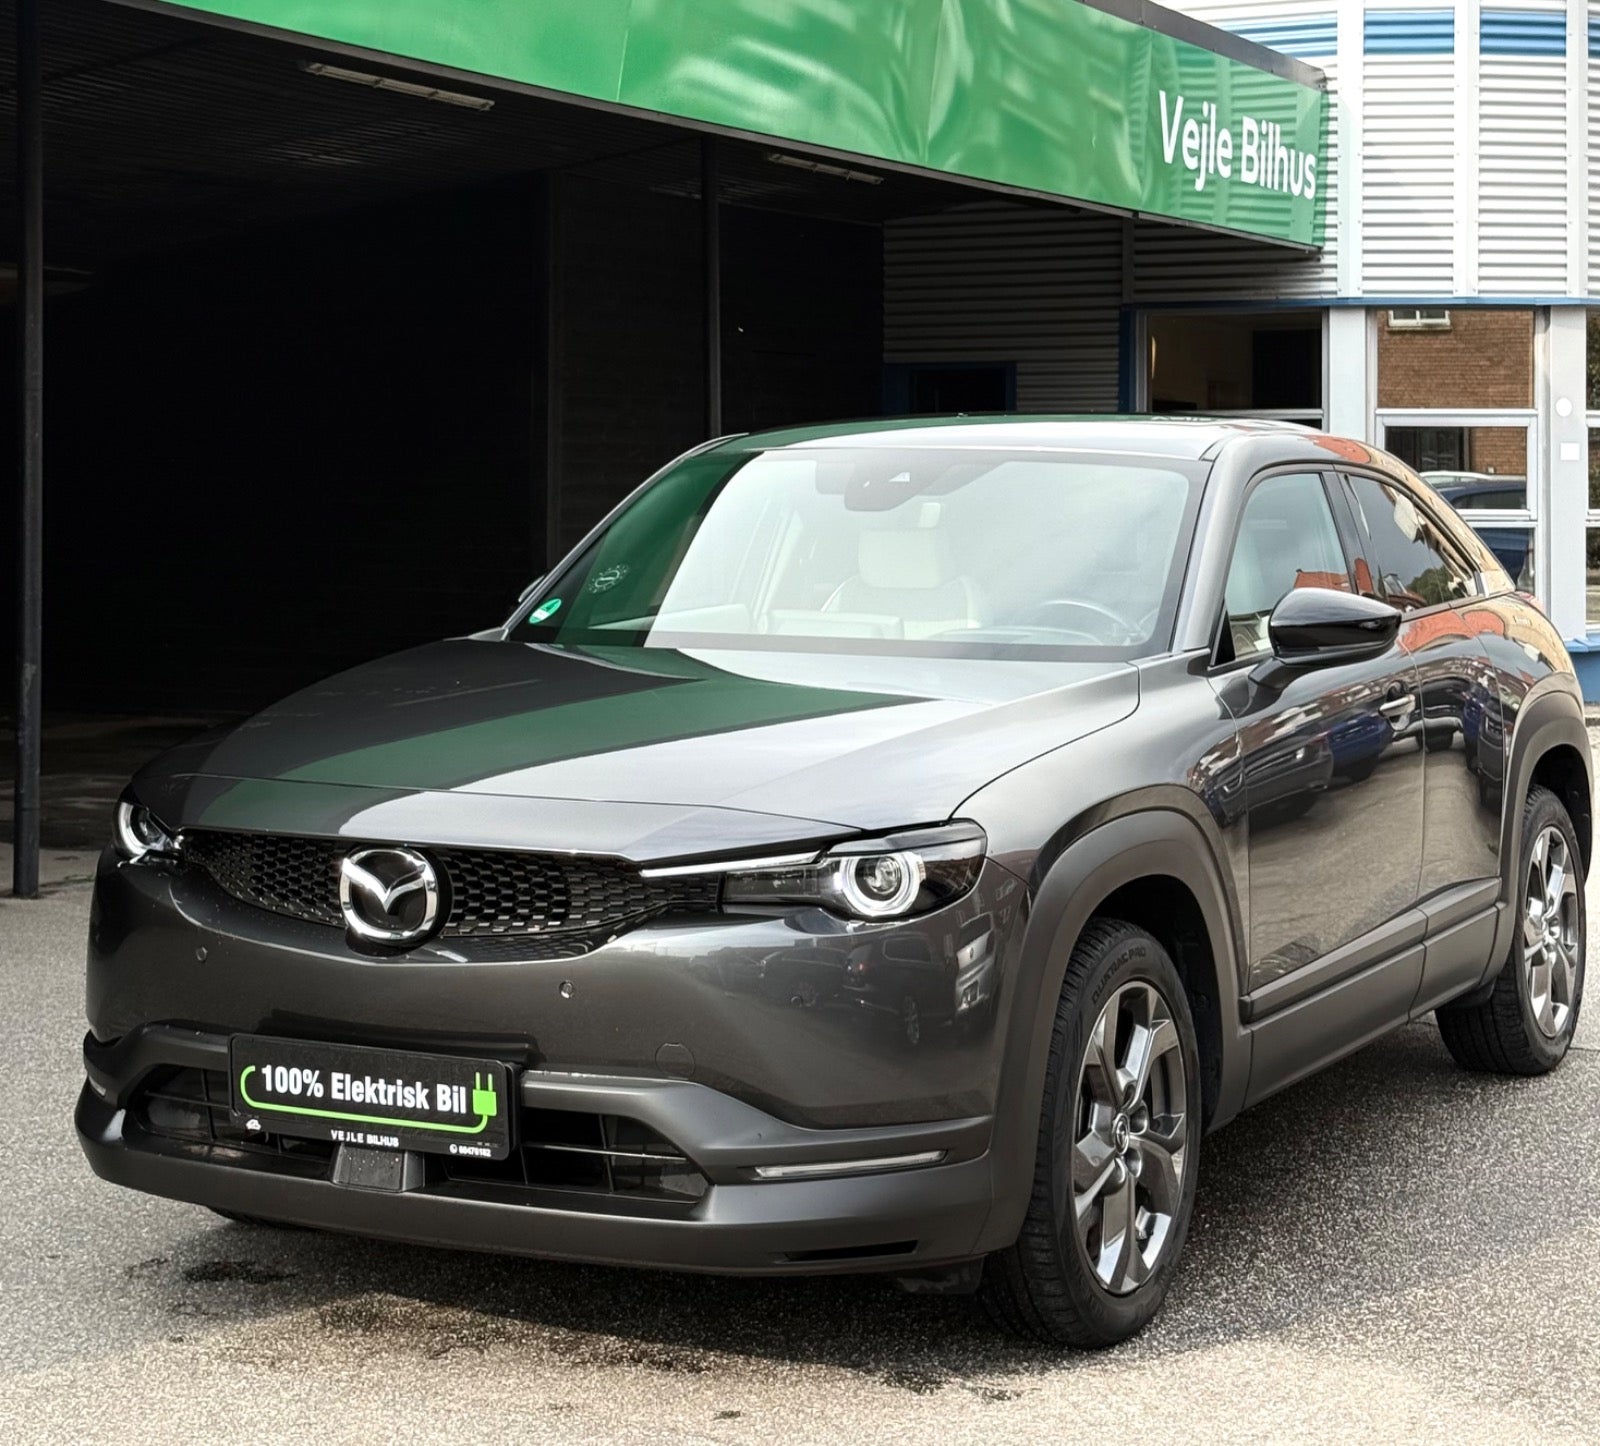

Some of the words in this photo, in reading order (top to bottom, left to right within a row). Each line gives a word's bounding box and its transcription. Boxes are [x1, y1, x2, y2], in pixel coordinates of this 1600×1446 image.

[1159, 90, 1233, 192] Vejle
[1240, 115, 1317, 200] Bilhus
[261, 1064, 324, 1098] 100%
[331, 1071, 430, 1110] Elektrisk
[436, 1083, 467, 1114] Bil
[330, 1129, 364, 1144] VEJLE
[366, 1133, 400, 1148] BILHUS
